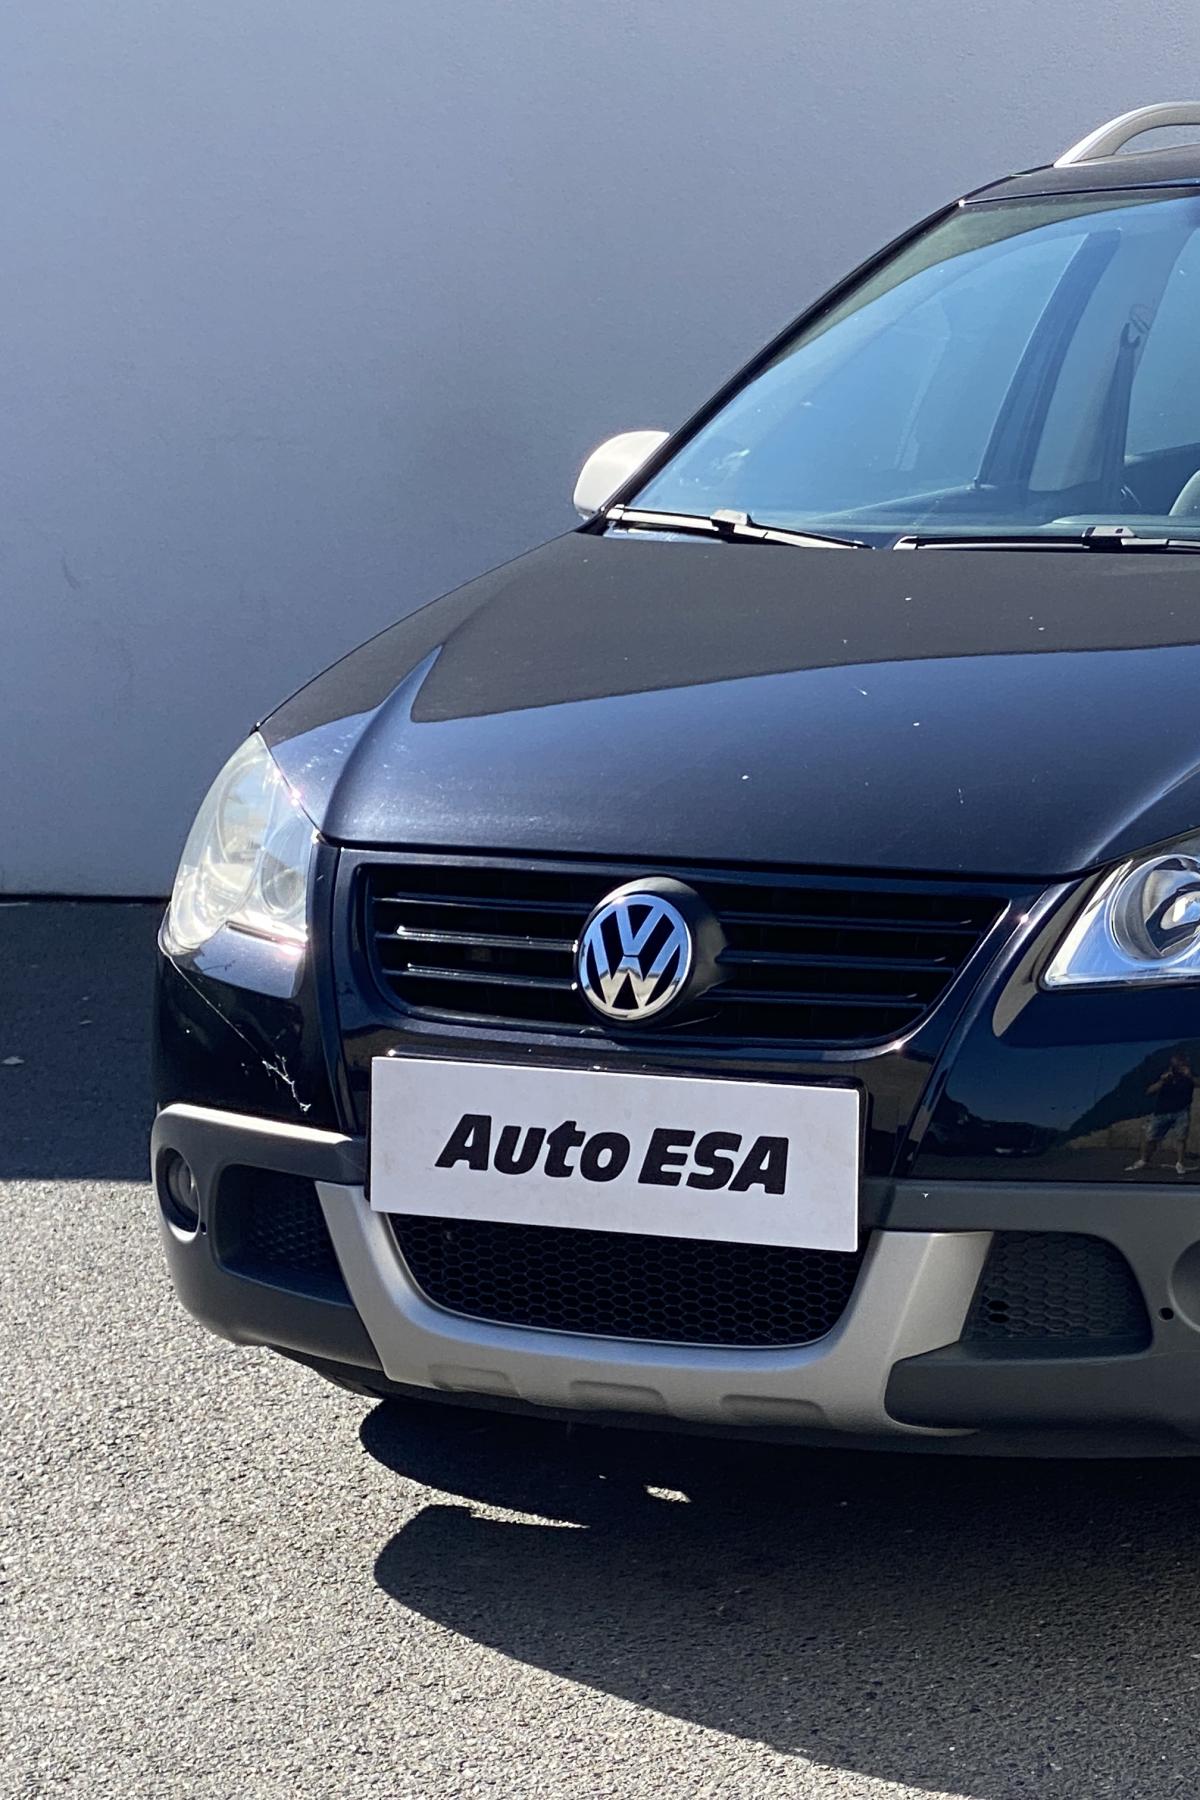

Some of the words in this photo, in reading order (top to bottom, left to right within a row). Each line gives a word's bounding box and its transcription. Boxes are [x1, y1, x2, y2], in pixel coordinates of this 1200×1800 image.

[578, 893, 692, 1020] VW
[434, 1113, 631, 1183] Auto
[637, 1127, 790, 1195] ESA
